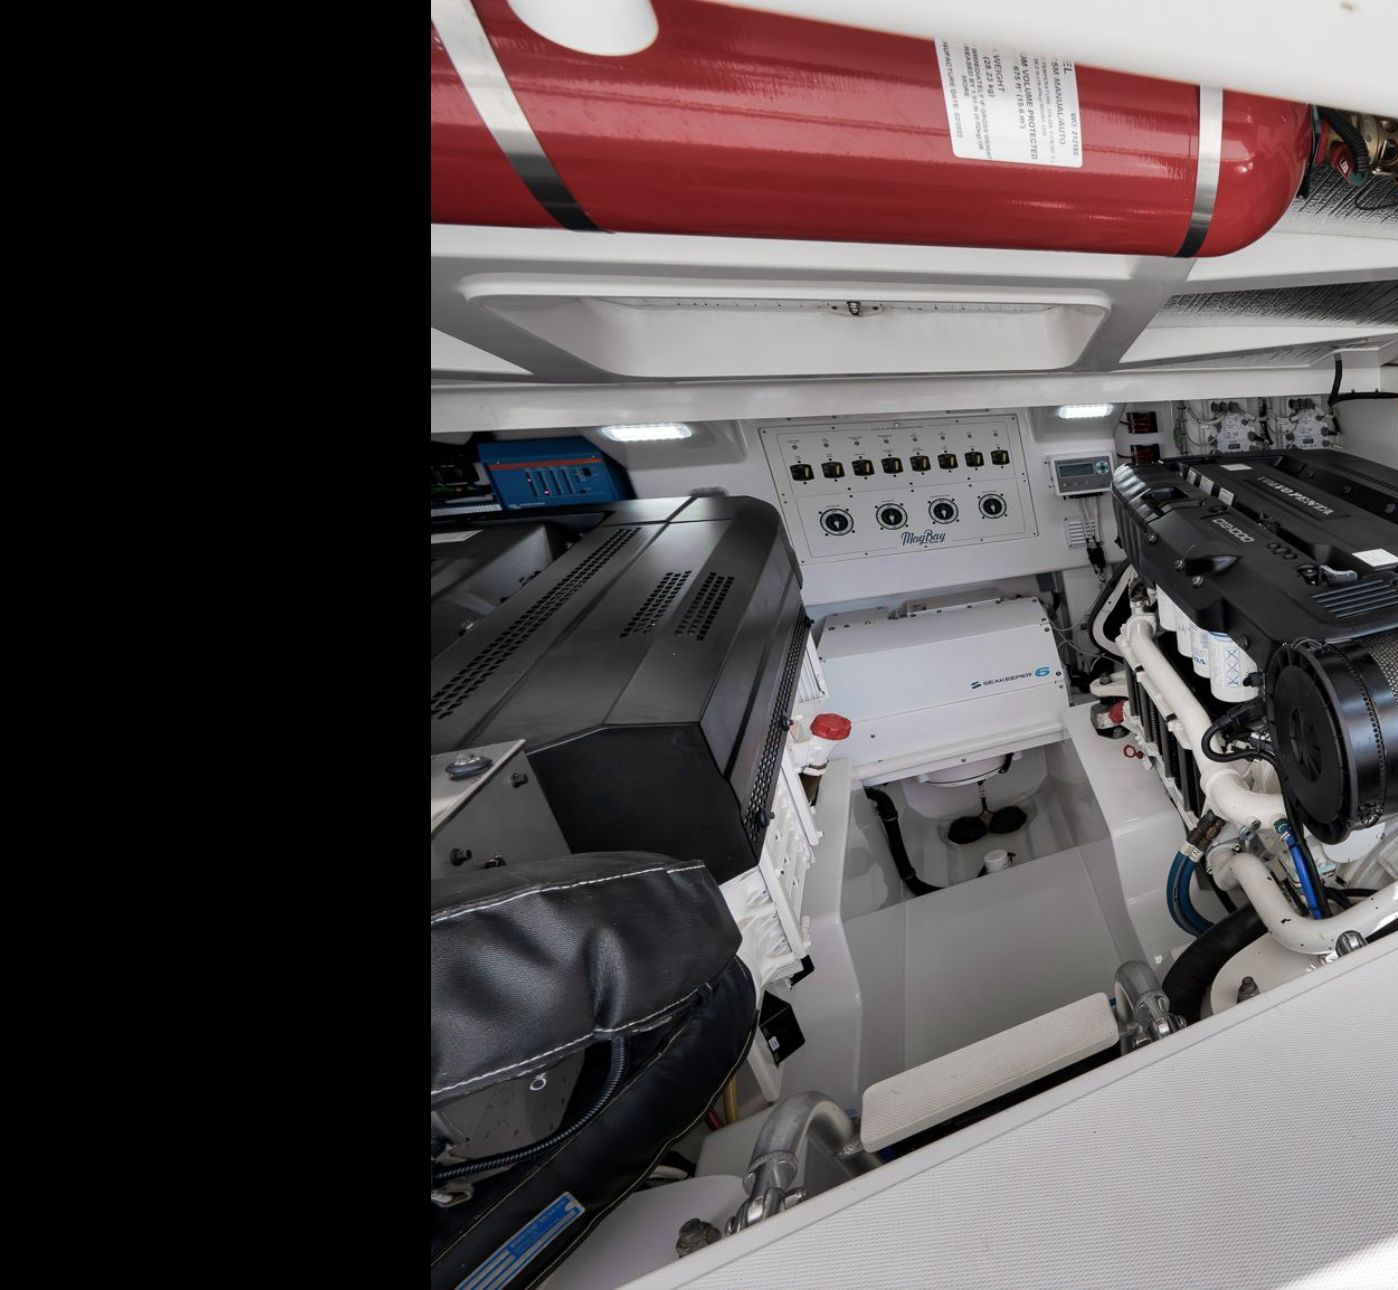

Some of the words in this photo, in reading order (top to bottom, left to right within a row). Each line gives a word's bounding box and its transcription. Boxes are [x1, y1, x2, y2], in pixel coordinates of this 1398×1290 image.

[992, 55, 1005, 92] WEIGHT
[1022, 69, 1034, 106] VOLUME
[1027, 109, 1038, 160] PROTECTED
[982, 672, 1032, 685] SEAKEEPER
[1034, 666, 1050, 677] 6
